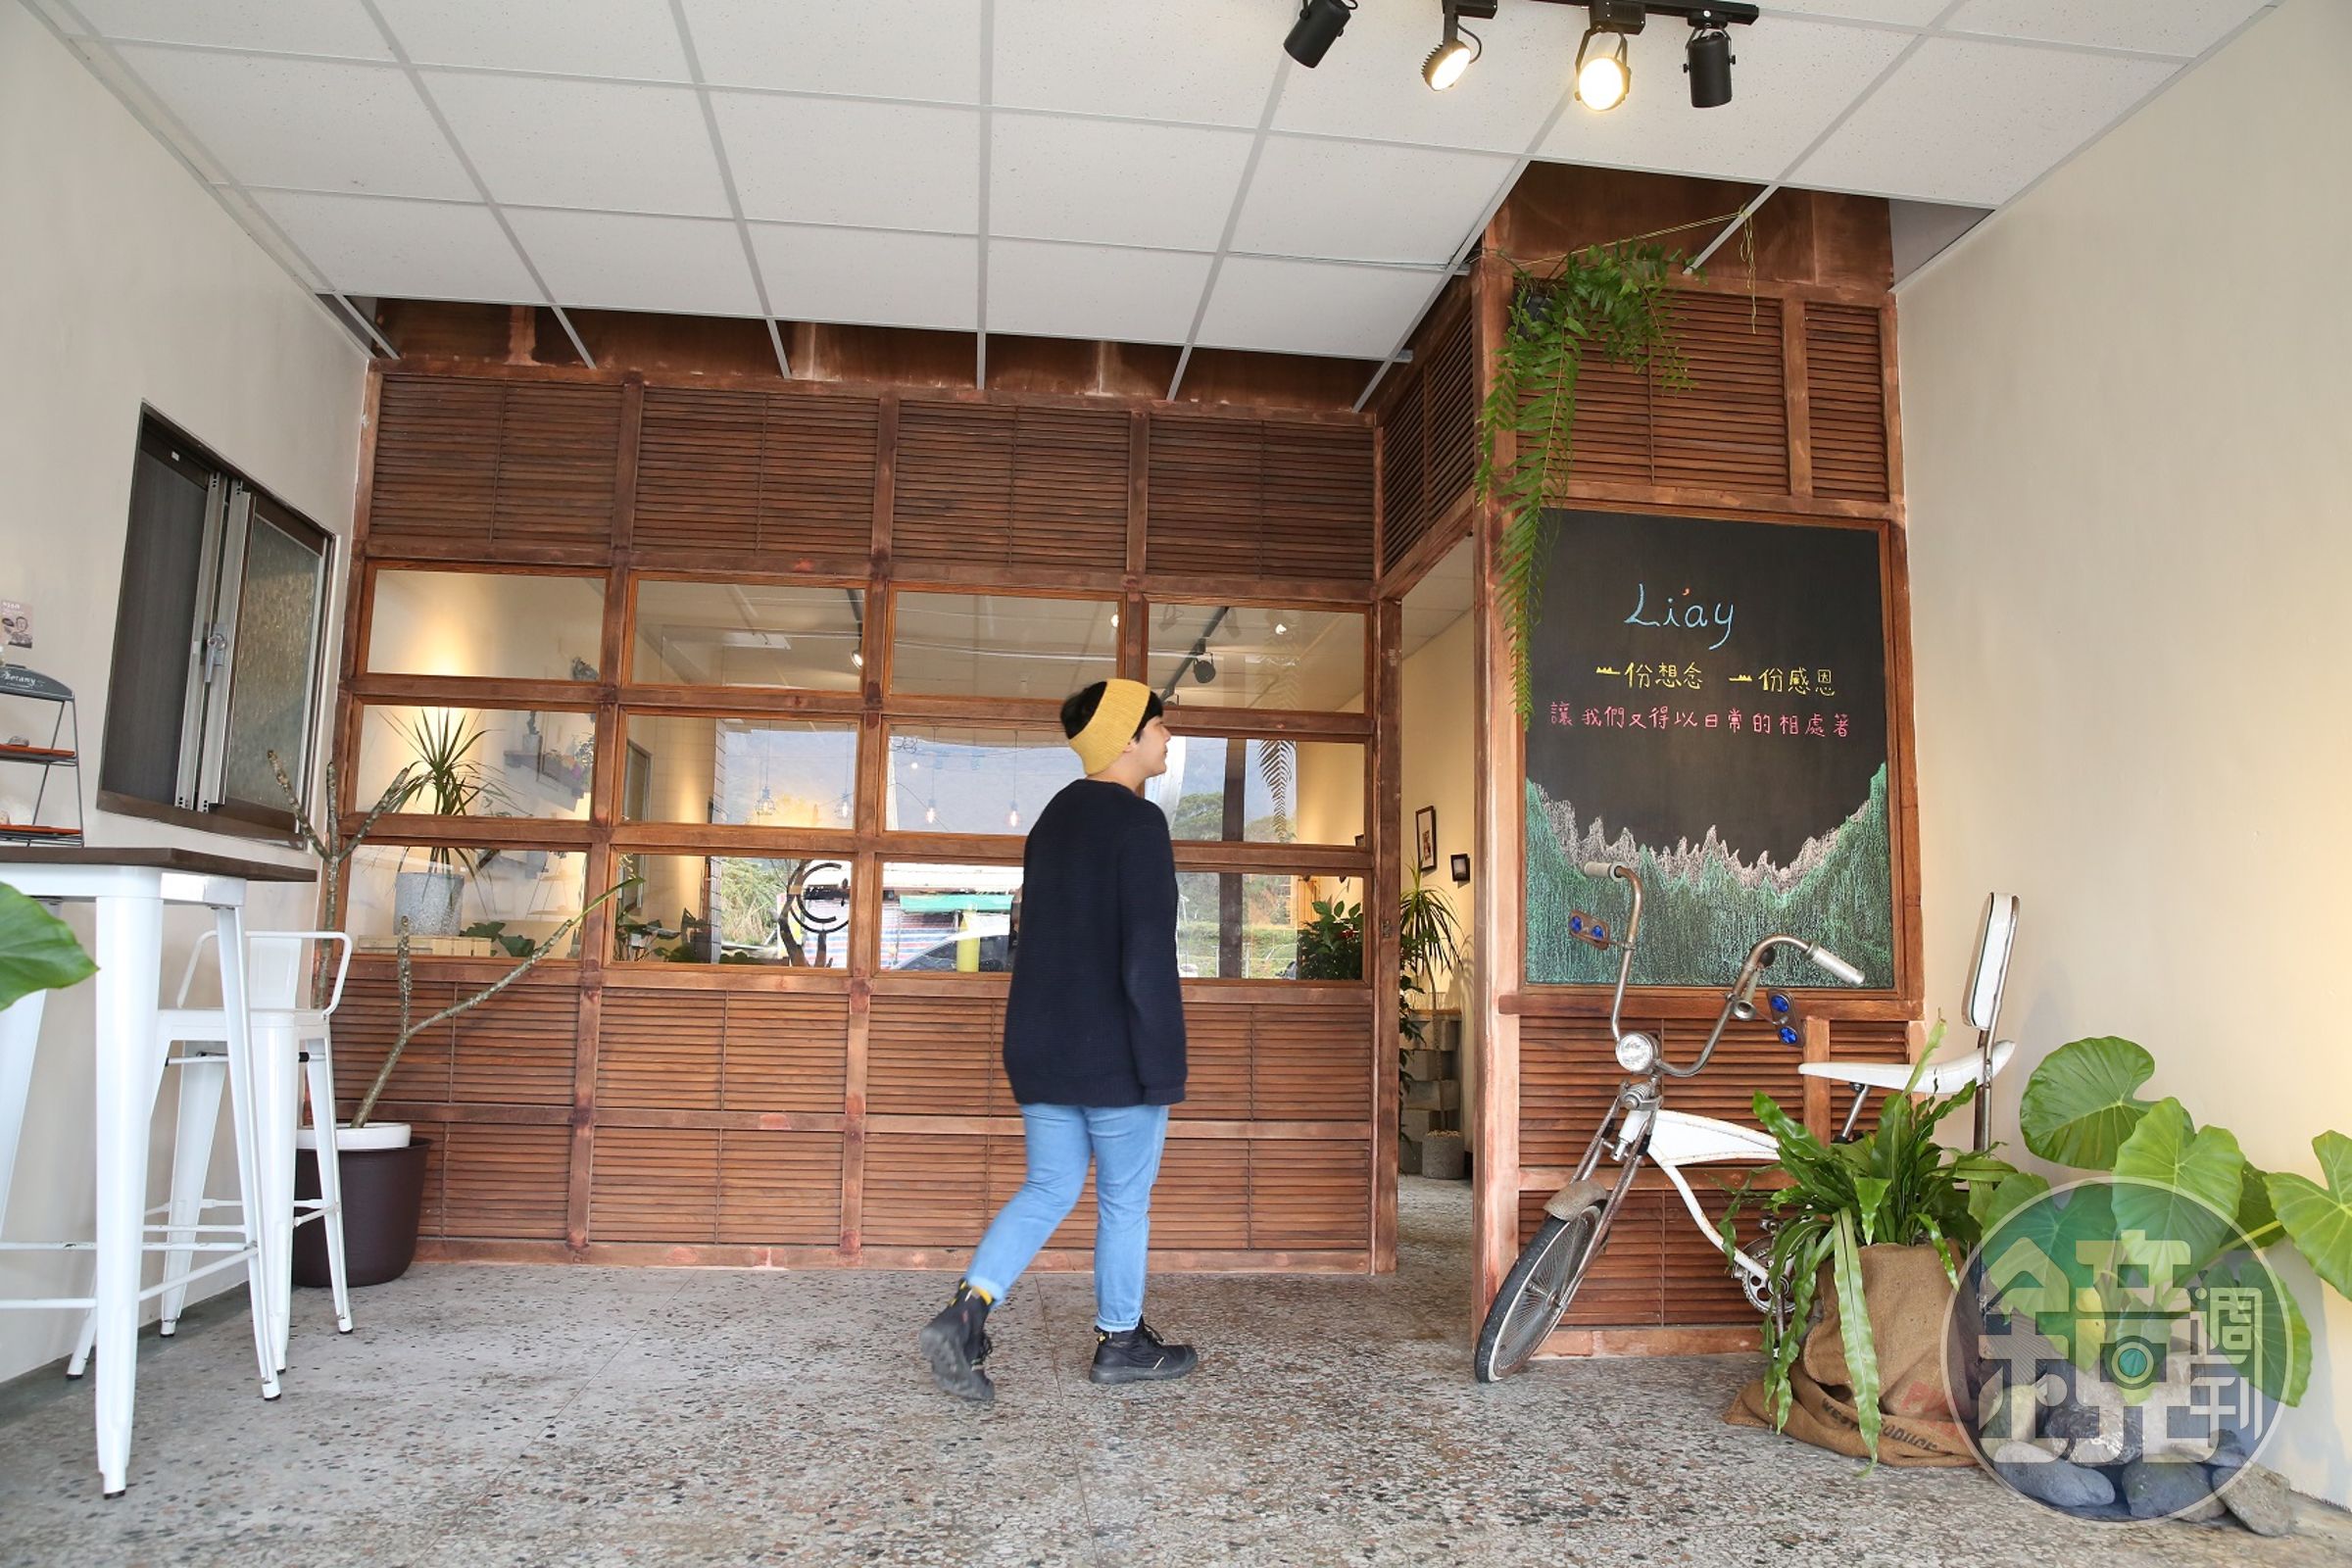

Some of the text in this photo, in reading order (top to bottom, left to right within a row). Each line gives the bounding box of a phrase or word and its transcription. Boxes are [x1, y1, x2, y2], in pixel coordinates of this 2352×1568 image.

[1595, 662, 1836, 697] 一份想念 一份感恩
